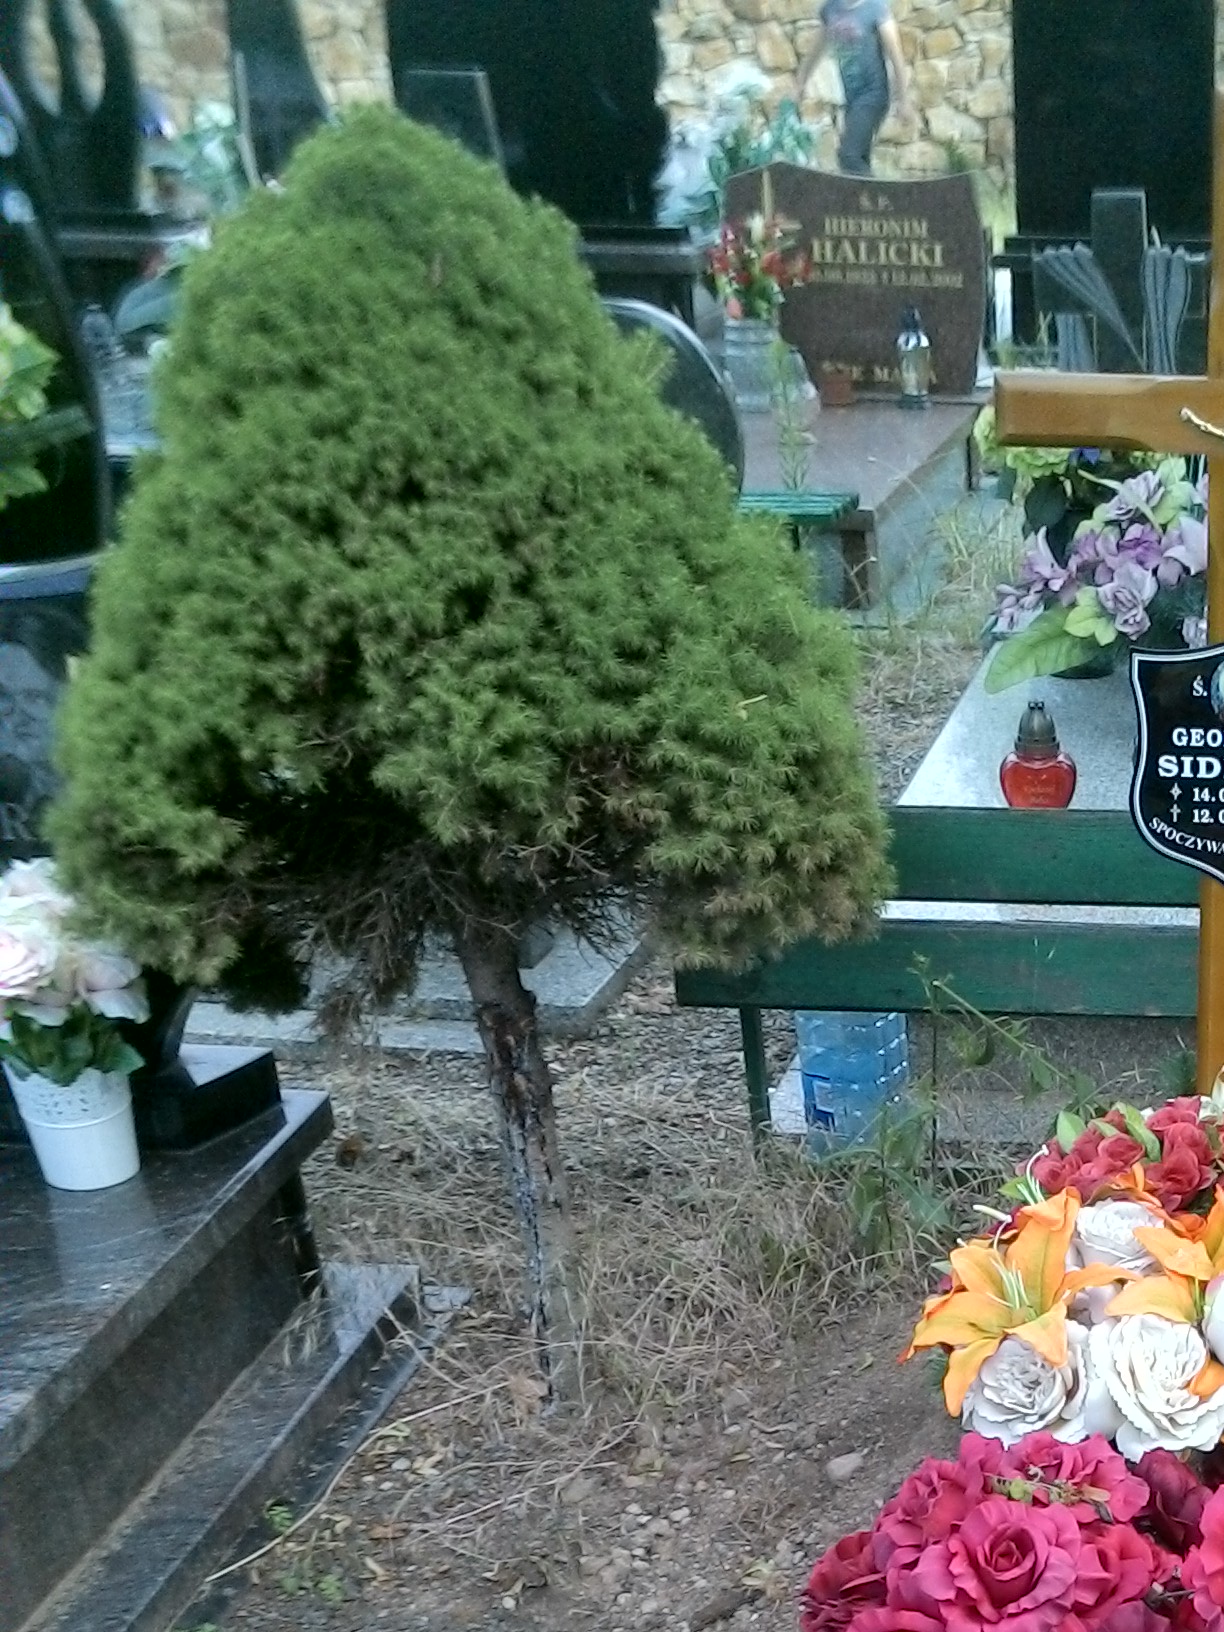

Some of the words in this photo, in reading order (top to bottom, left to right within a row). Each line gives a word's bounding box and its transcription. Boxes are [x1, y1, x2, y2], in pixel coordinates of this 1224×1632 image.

[824, 216, 929, 238] HIERONIM
[811, 239, 945, 267] HALICKI
[1193, 675, 1208, 697] Ś.
